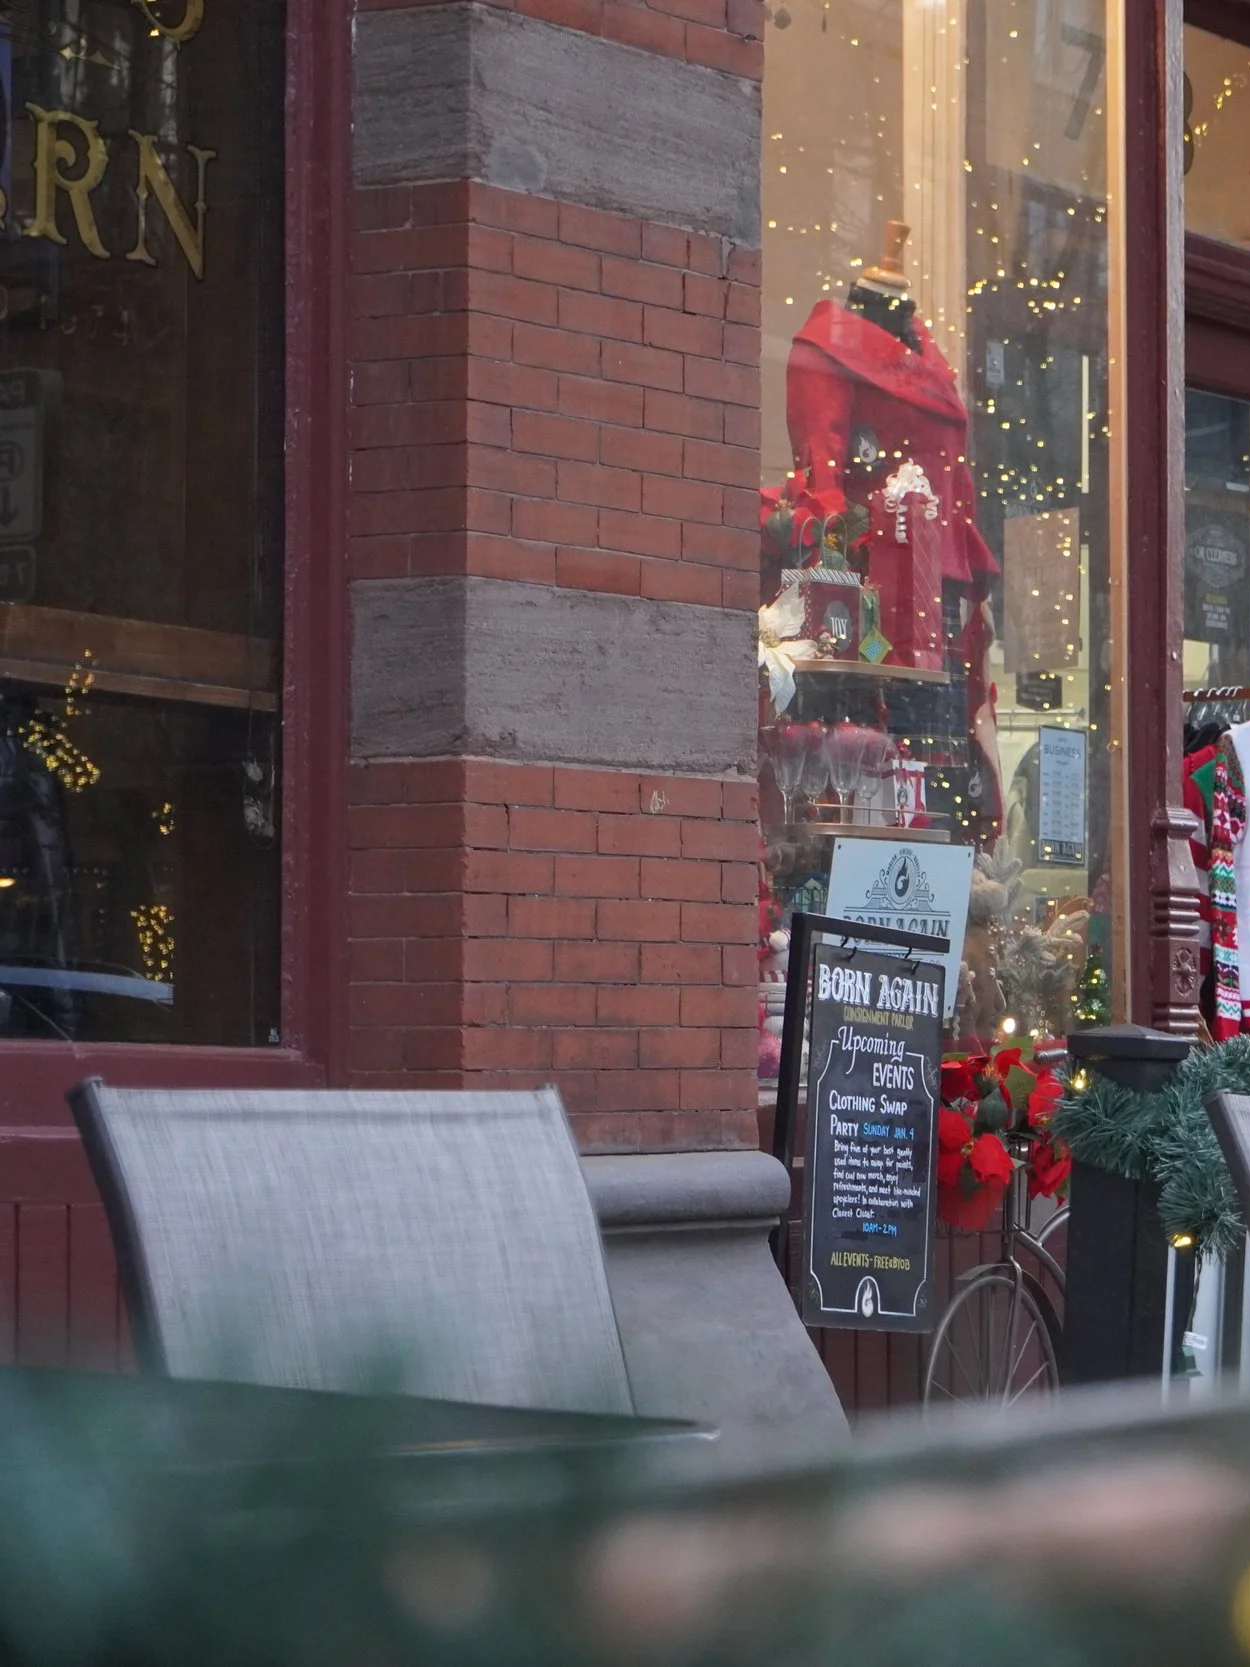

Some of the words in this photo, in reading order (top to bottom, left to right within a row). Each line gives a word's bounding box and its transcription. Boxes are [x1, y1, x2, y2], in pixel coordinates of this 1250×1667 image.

[0, 101, 216, 281] RN
[830, 616, 848, 640] JOY
[818, 963, 873, 1006] BORN
[877, 974, 940, 1018] AGAIN
[844, 1006, 890, 1026] CONSIGNMENT
[891, 1013, 914, 1031] PARLOR
[838, 1026, 907, 1074] Upcoming
[872, 1062, 914, 1090] EVENTS
[863, 1122, 890, 1138] SUNDAY
